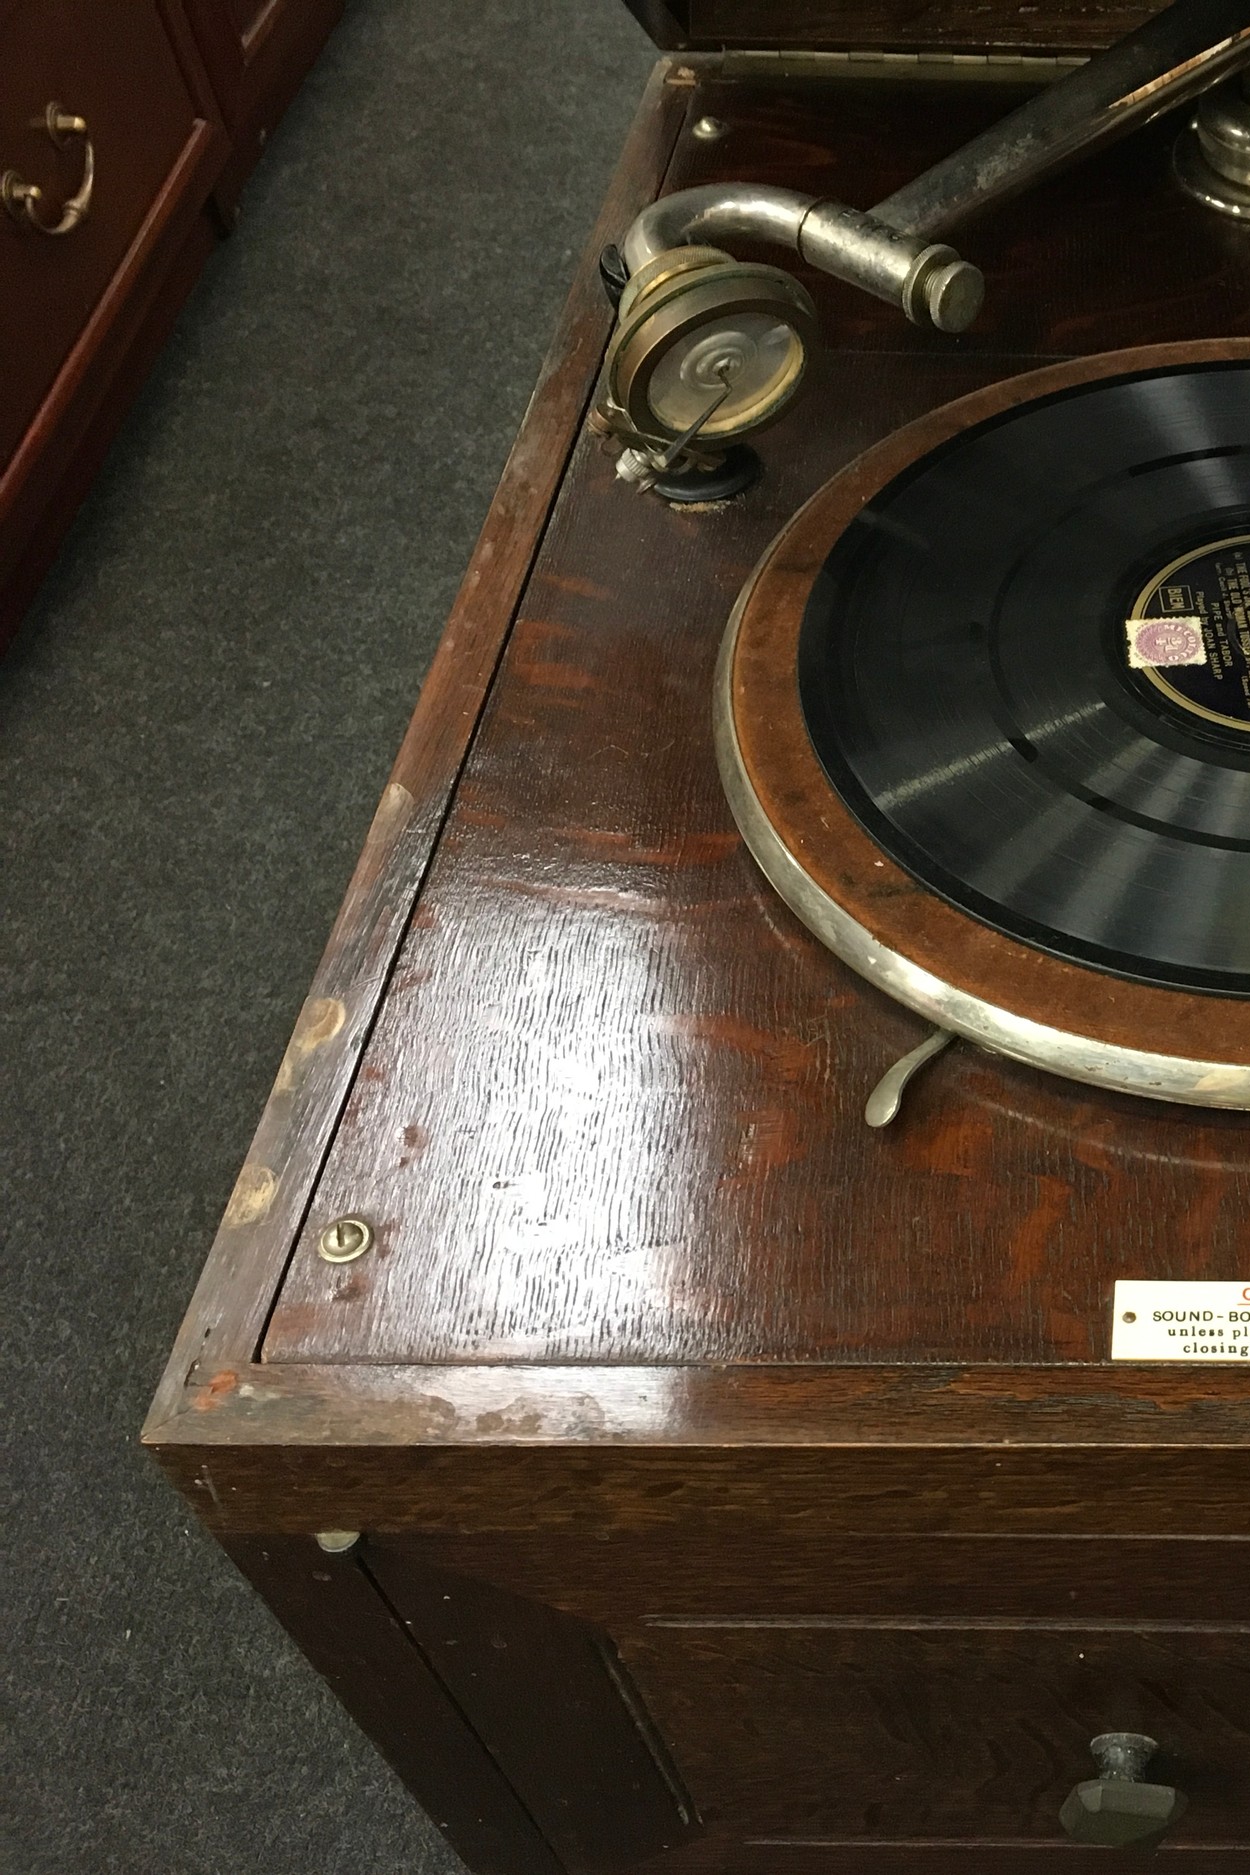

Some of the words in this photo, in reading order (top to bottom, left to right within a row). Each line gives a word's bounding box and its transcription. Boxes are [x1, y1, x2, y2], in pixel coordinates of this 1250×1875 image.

[1237, 562, 1247, 574] THE
[1227, 578, 1238, 590] THE
[1168, 587, 1185, 609] BIEM
[1194, 591, 1207, 614] Played
[1231, 592, 1242, 604] OLD
[1211, 602, 1221, 620] PIPE
[1216, 623, 1225, 637] and
[1204, 628, 1215, 649] JOAN
[1220, 640, 1232, 667] TABOR
[1209, 652, 1222, 680] SHARP
[1167, 1326, 1224, 1337] unless
[1183, 1342, 1249, 1357] closing
